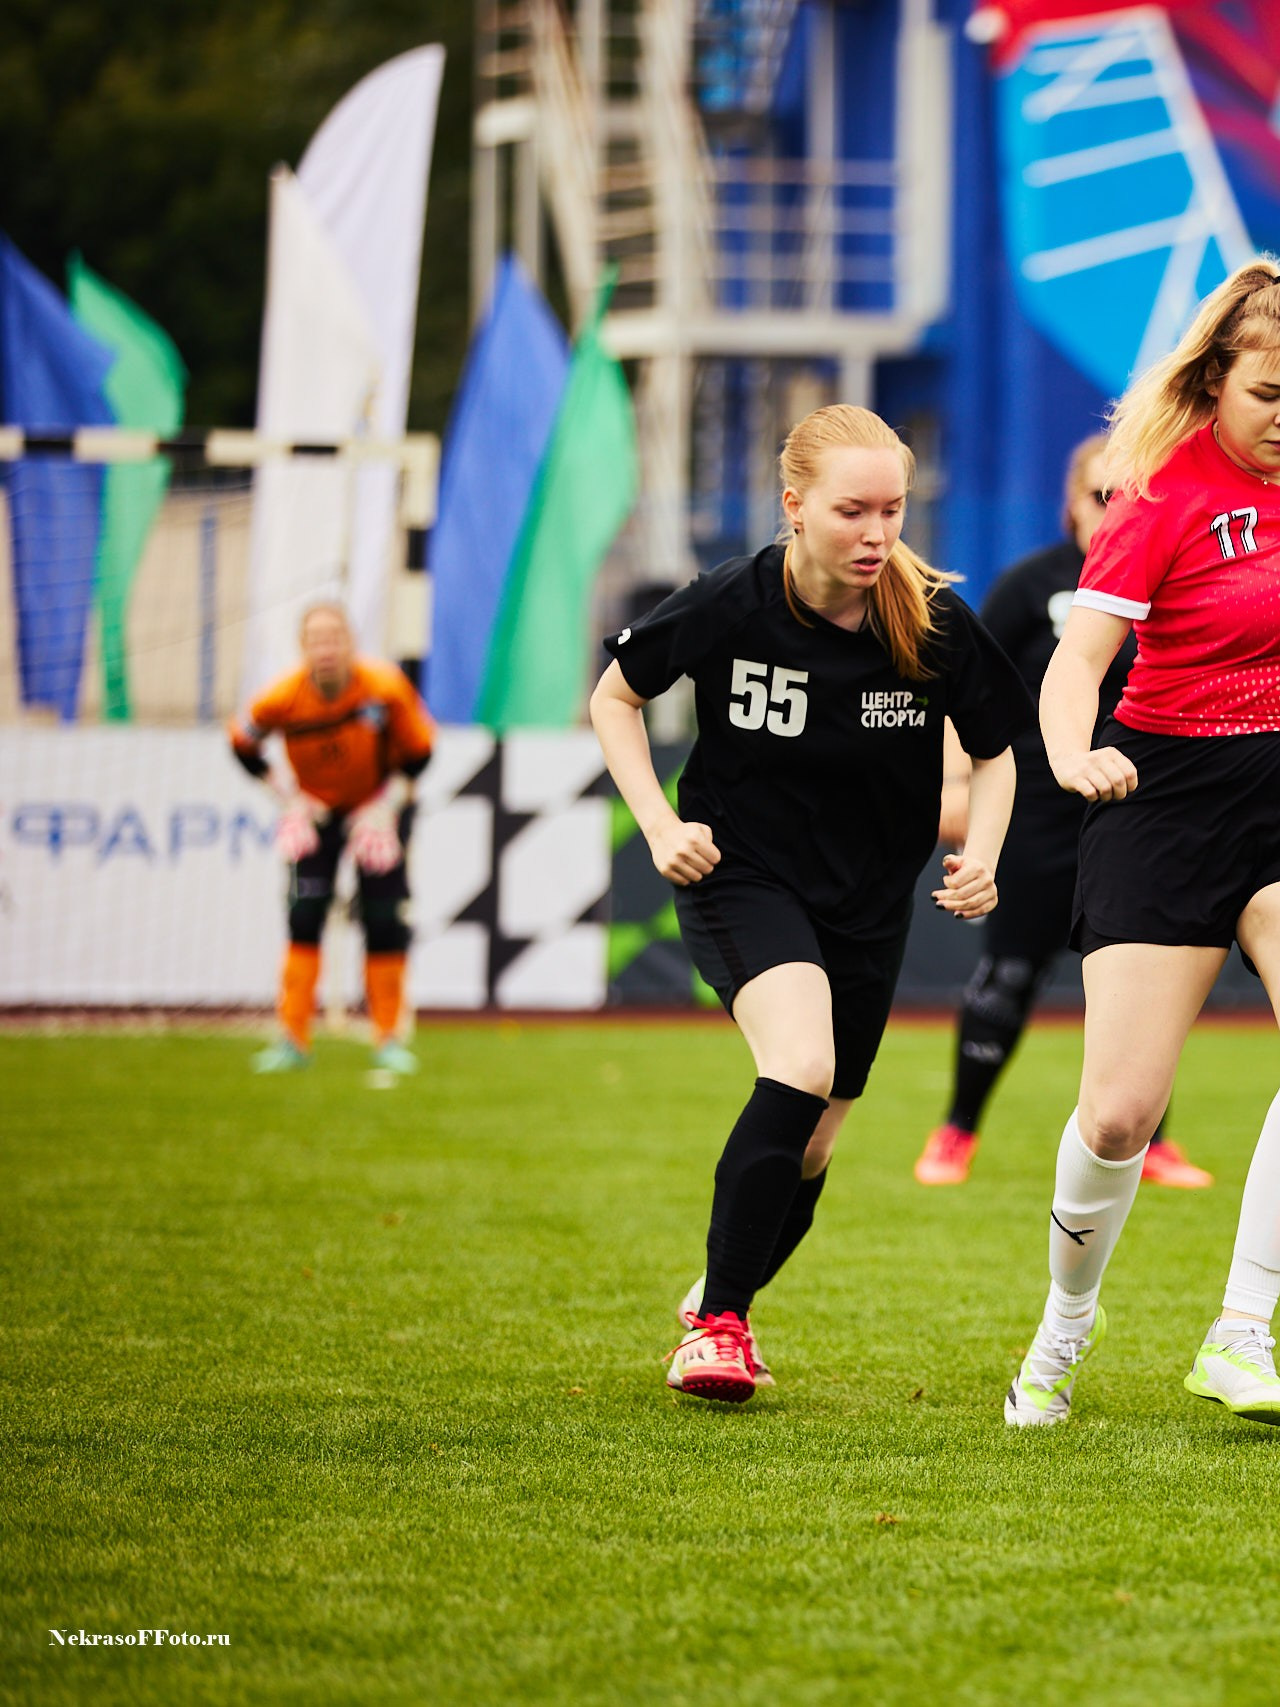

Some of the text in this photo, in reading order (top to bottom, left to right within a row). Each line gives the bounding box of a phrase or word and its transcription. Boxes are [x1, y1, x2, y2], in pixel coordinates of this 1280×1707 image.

[1209, 506, 1258, 560] 17
[729, 658, 809, 738] 55
[861, 691, 914, 711] ЦЕНТР
[860, 709, 927, 728] СПОРТА
